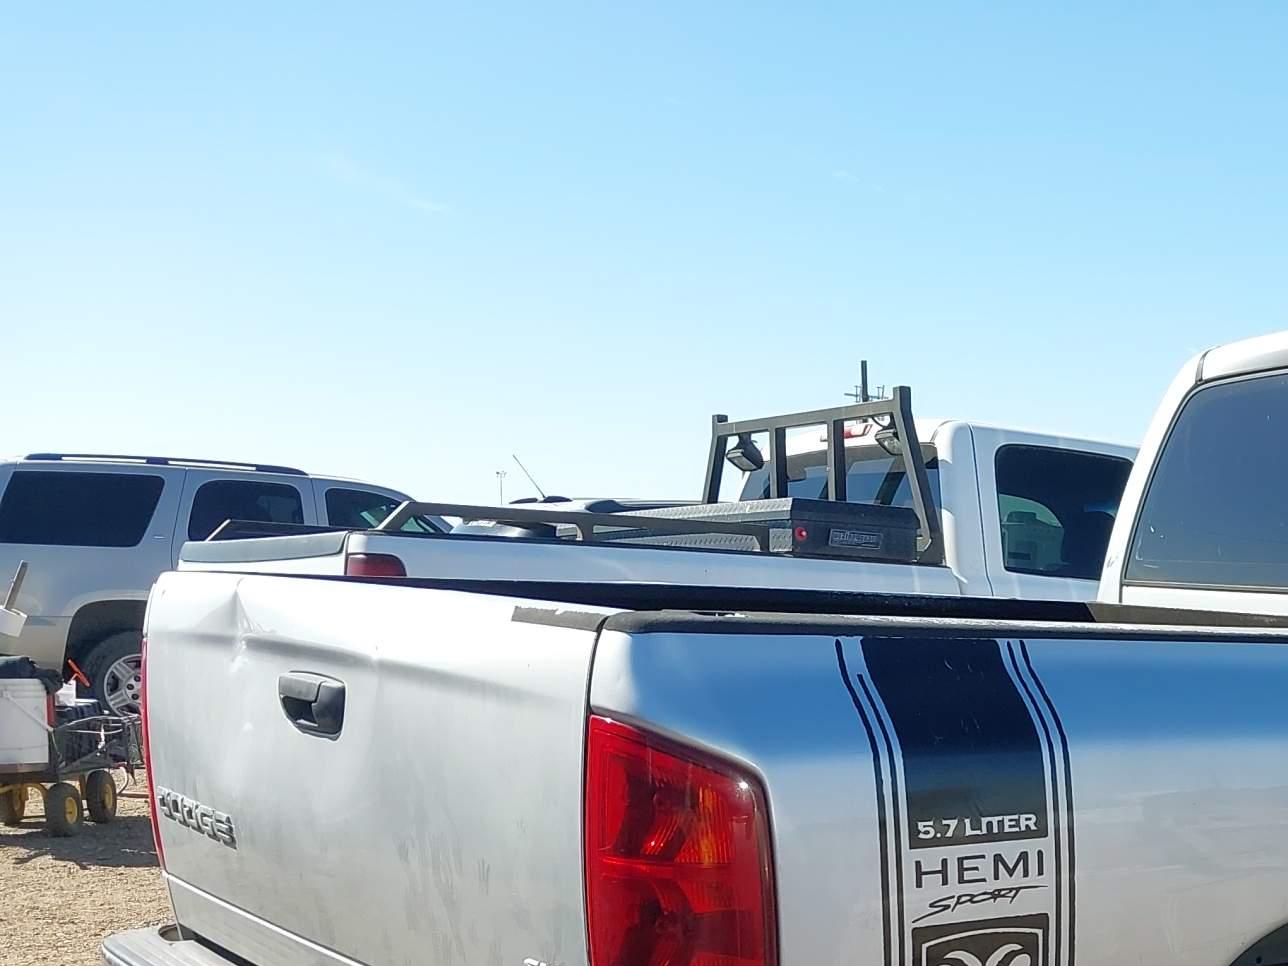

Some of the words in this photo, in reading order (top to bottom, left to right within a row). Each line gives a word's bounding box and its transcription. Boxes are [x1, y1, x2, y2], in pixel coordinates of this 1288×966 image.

[157, 785, 239, 851] DODGE
[916, 818, 959, 840] 5.7
[963, 812, 1038, 837] LITER
[914, 849, 1045, 889] HEMI
